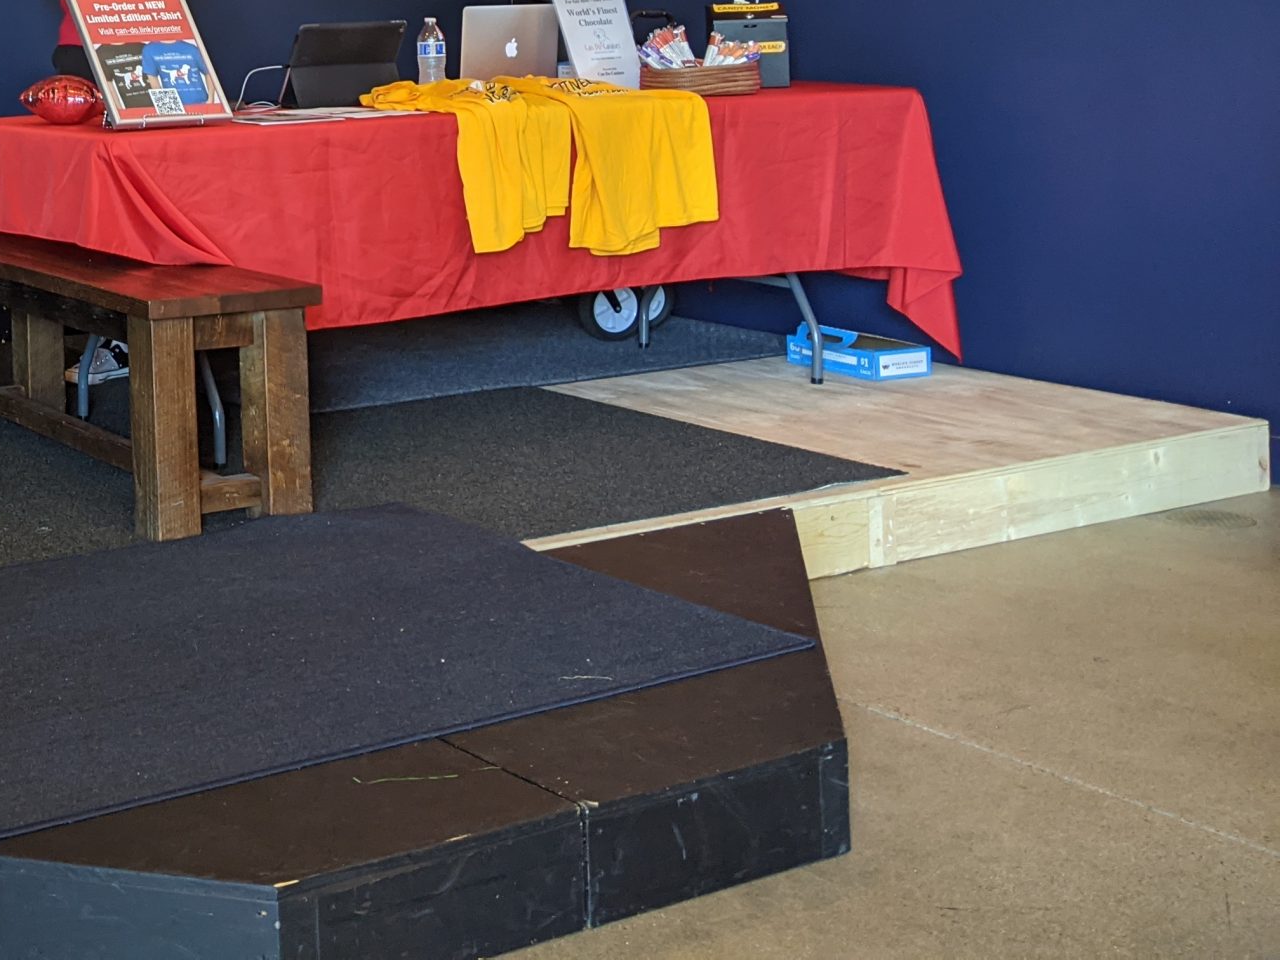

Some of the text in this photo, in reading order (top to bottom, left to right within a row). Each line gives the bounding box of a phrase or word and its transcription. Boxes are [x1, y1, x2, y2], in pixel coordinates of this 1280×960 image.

[93, 2, 136, 11] Pre-Order
[145, 1, 166, 10] NEW
[566, 7, 618, 17] World's Finest
[86, 11, 183, 24] Limited Edition T-Shirt
[578, 18, 613, 27] Chocolate
[98, 27, 115, 36] Visit
